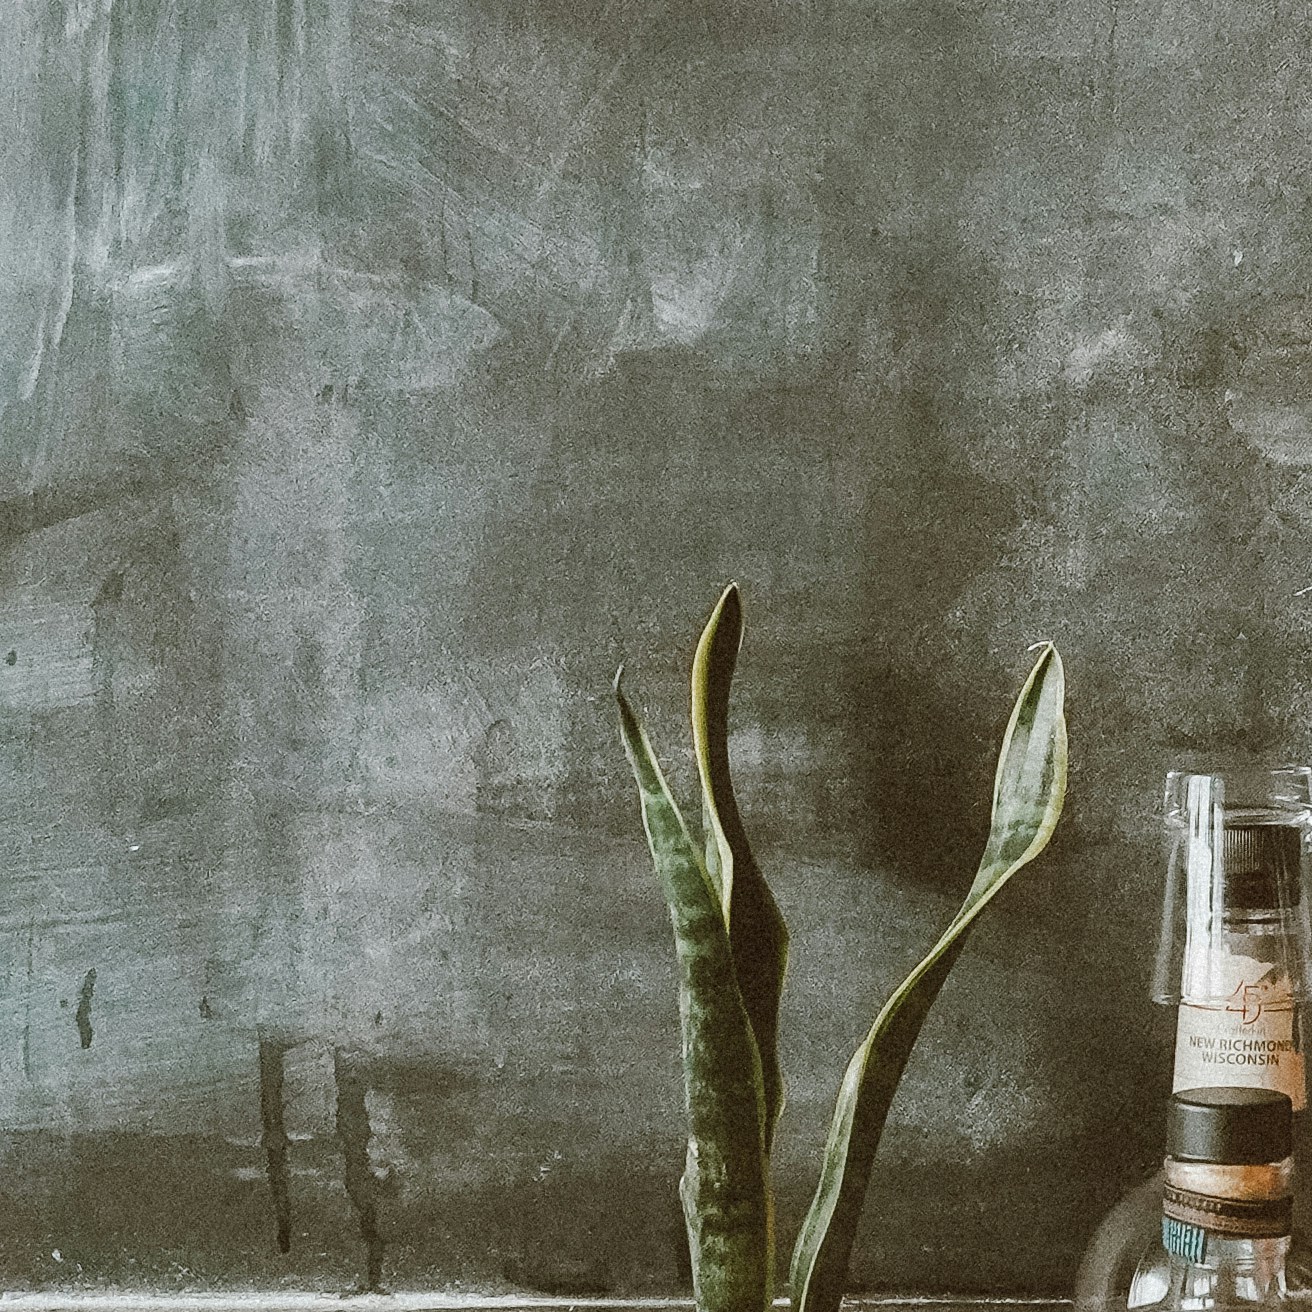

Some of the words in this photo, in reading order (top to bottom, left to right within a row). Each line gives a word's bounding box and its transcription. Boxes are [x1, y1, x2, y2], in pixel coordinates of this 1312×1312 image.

[1189, 1035, 1216, 1049] NEW
[1220, 1038, 1292, 1052] RICHMOND
[1202, 1051, 1280, 1066] WISCONSIN
